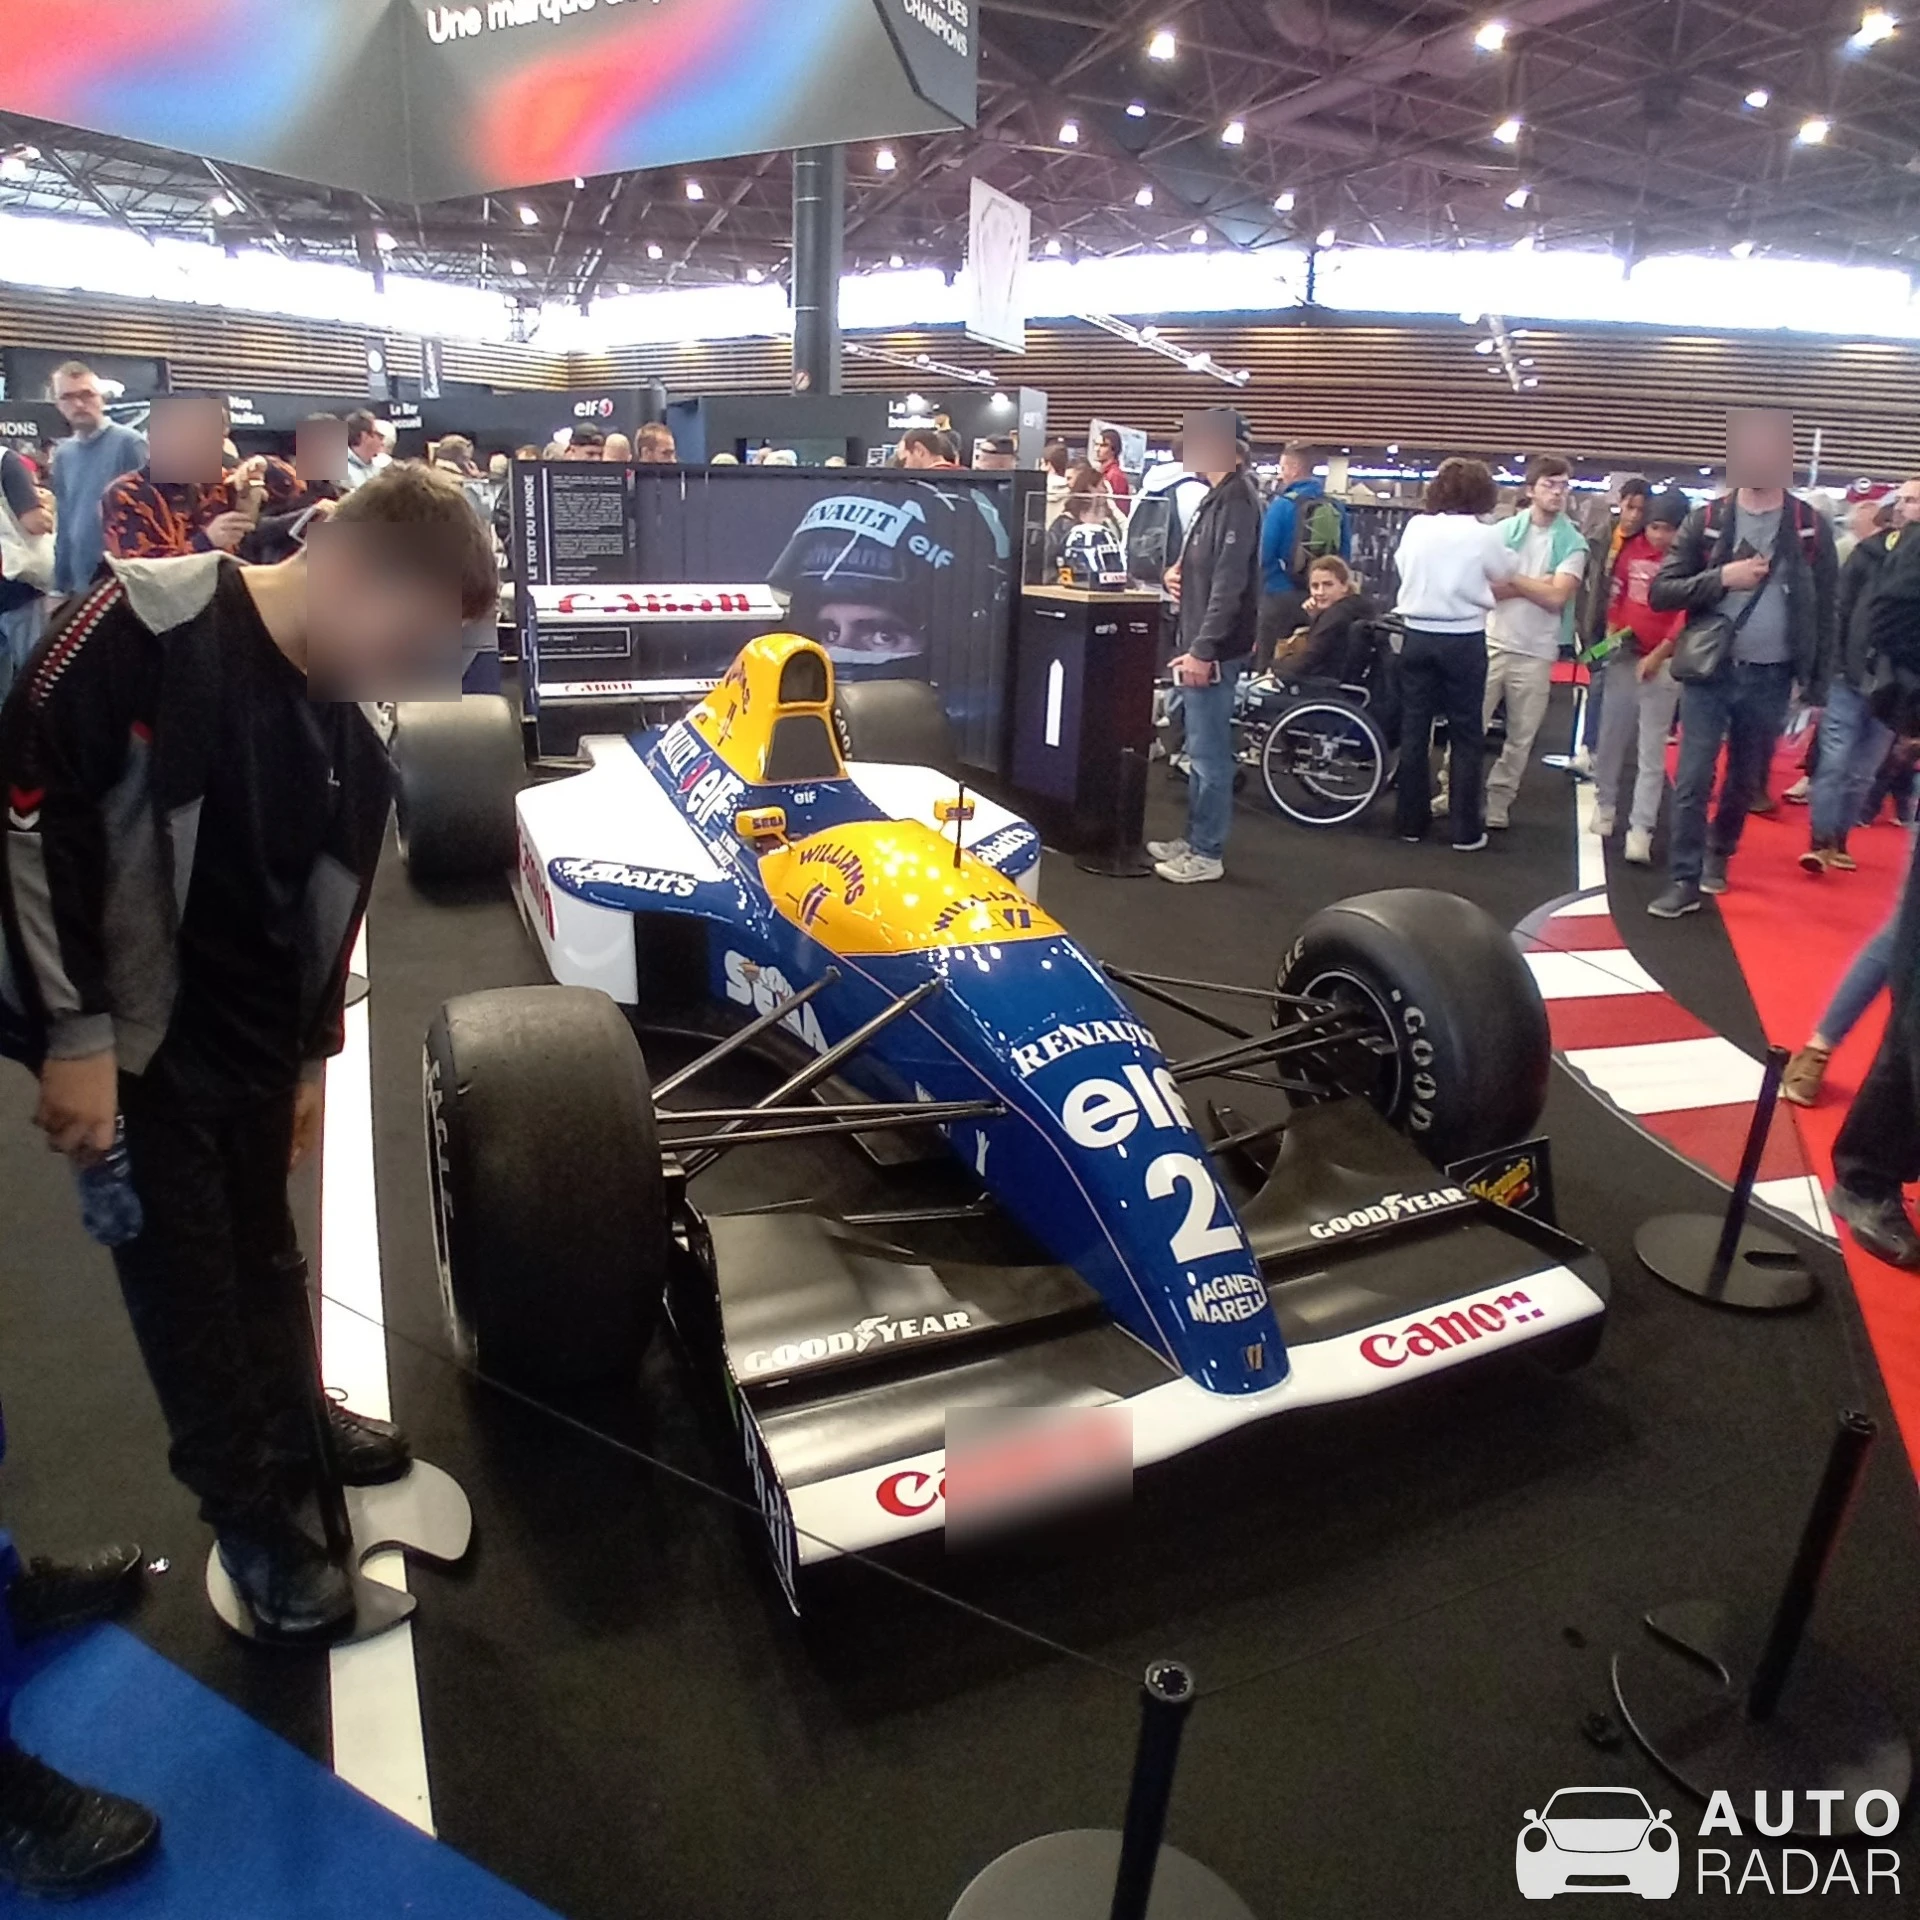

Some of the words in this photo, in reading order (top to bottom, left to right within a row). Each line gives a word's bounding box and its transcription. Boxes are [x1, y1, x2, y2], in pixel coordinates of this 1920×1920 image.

[427, 6, 483, 44] Une
[573, 399, 599, 417] elf
[0, 421, 38, 437] IONS
[523, 474, 536, 518] MONDE
[525, 519, 537, 537] DU
[526, 537, 538, 565] TOIT
[908, 534, 955, 570] elf
[527, 565, 538, 580] LE
[793, 790, 817, 805] elf
[799, 842, 866, 906] WILLIAMS
[1010, 1020, 1163, 1079] RENAULT
[1061, 1063, 1195, 1150] elf
[1144, 1152, 1244, 1265] 2
[1308, 1187, 1468, 1240] GOODYEAR
[743, 1309, 972, 1374] GOODYEAR
[1360, 1288, 1545, 1370] Canon
